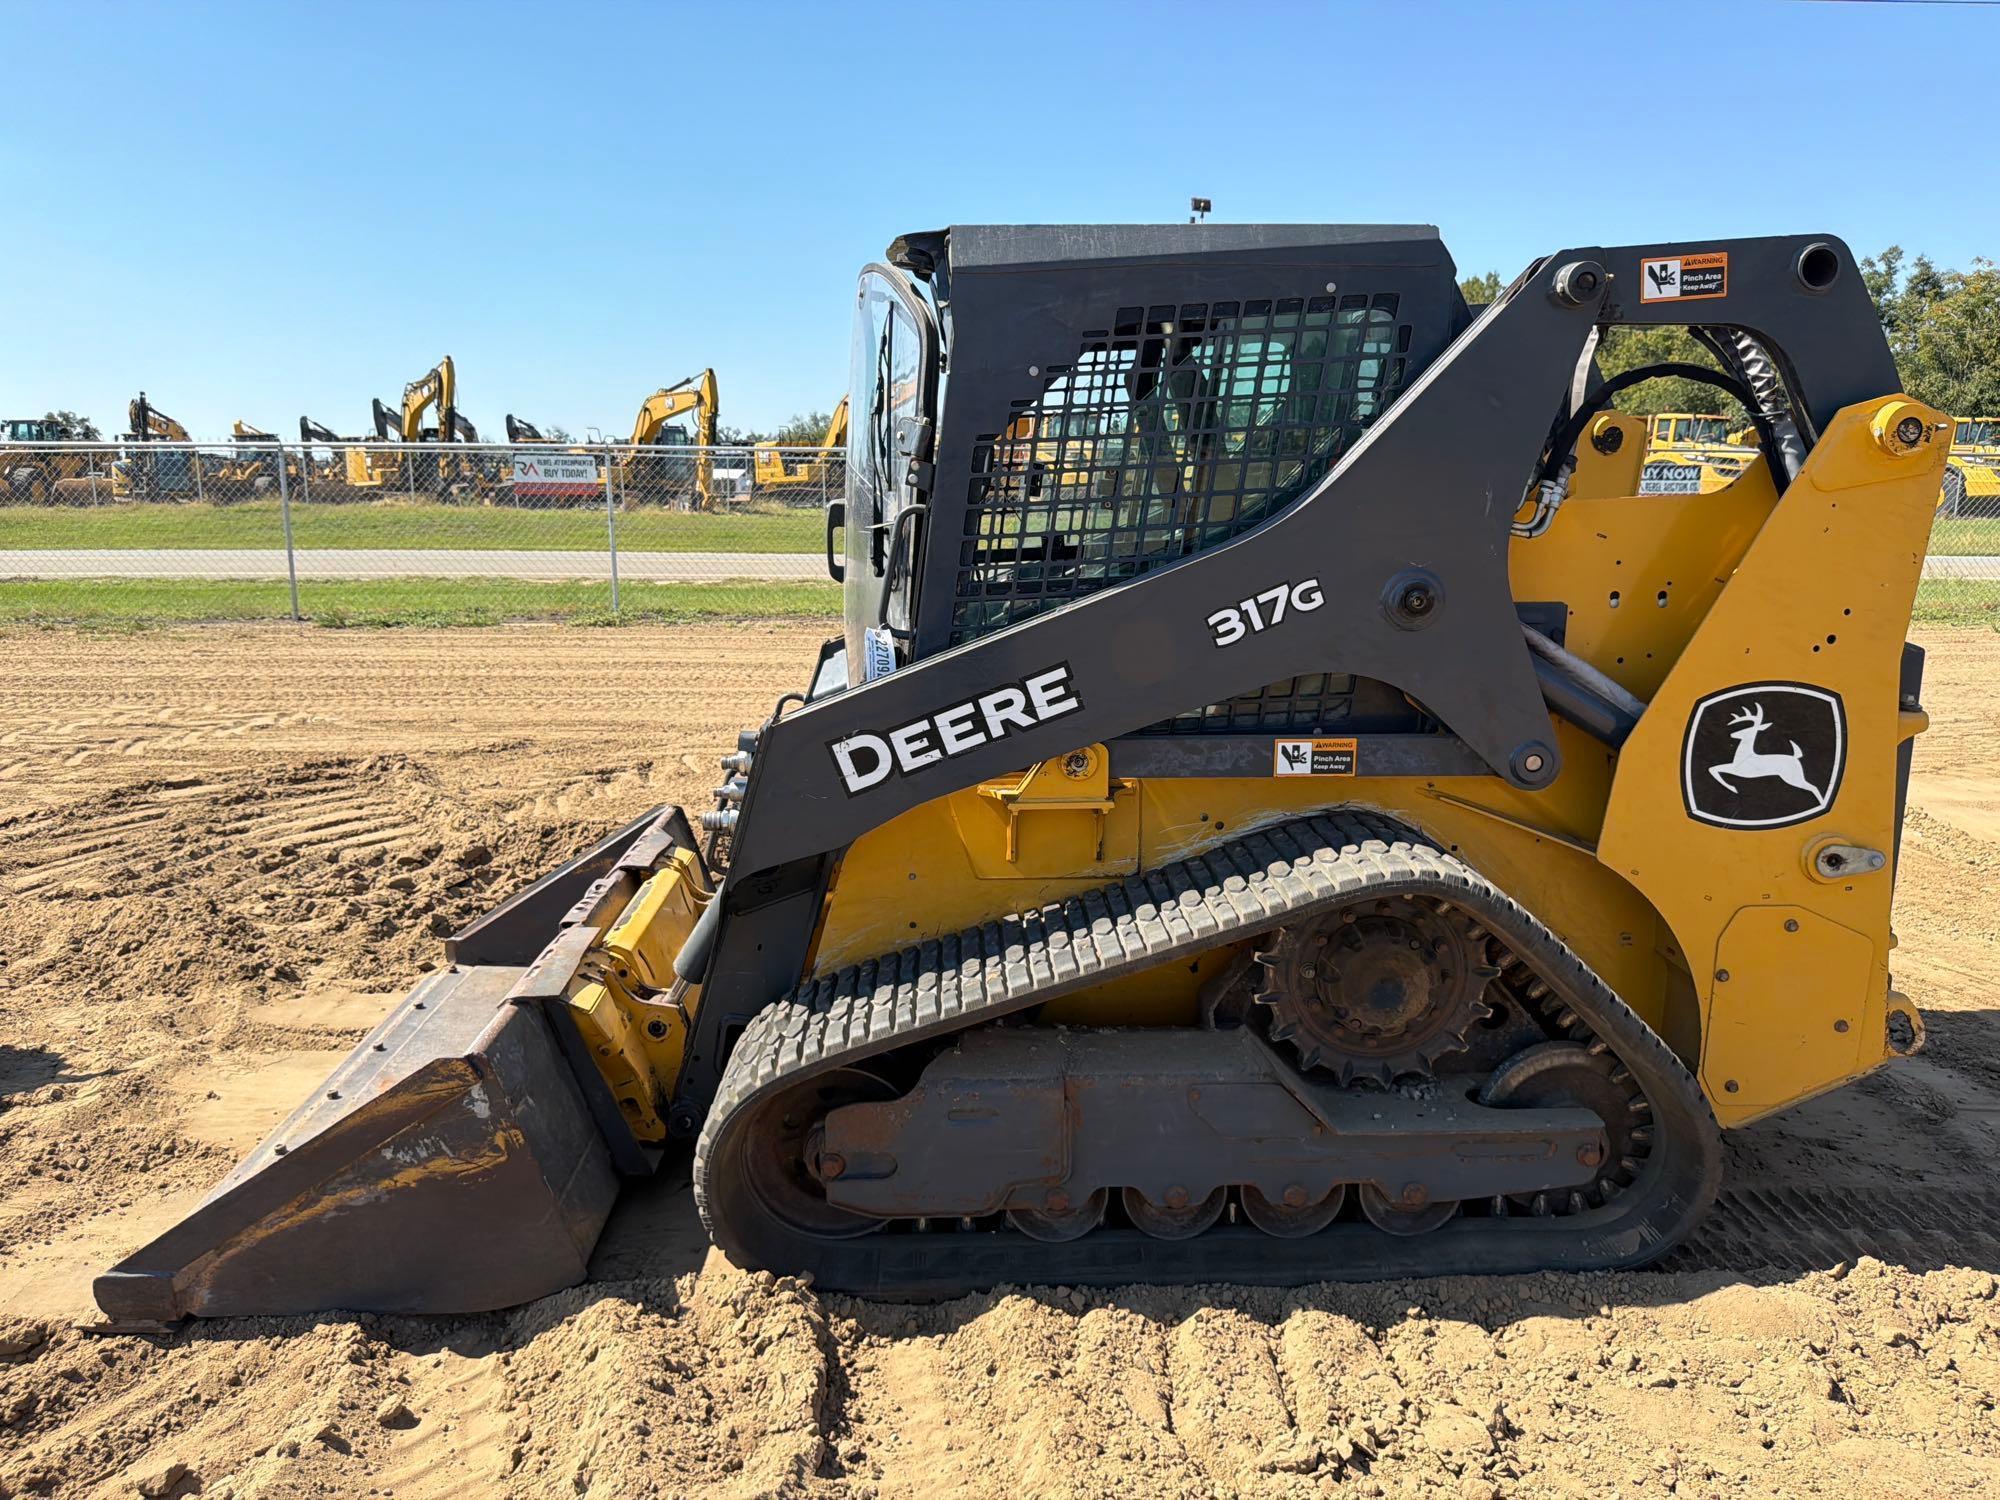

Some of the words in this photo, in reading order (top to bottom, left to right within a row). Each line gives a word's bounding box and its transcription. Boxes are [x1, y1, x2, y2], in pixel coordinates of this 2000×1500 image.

[1690, 257, 1723, 265] WARNING
[1683, 274, 1703, 282] Pinch
[544, 468, 559, 478] BUY
[561, 468, 588, 479] TODAY!
[1663, 467, 1699, 479] NOW
[1208, 579, 1325, 646] 317G
[832, 667, 1079, 792] DEERE
